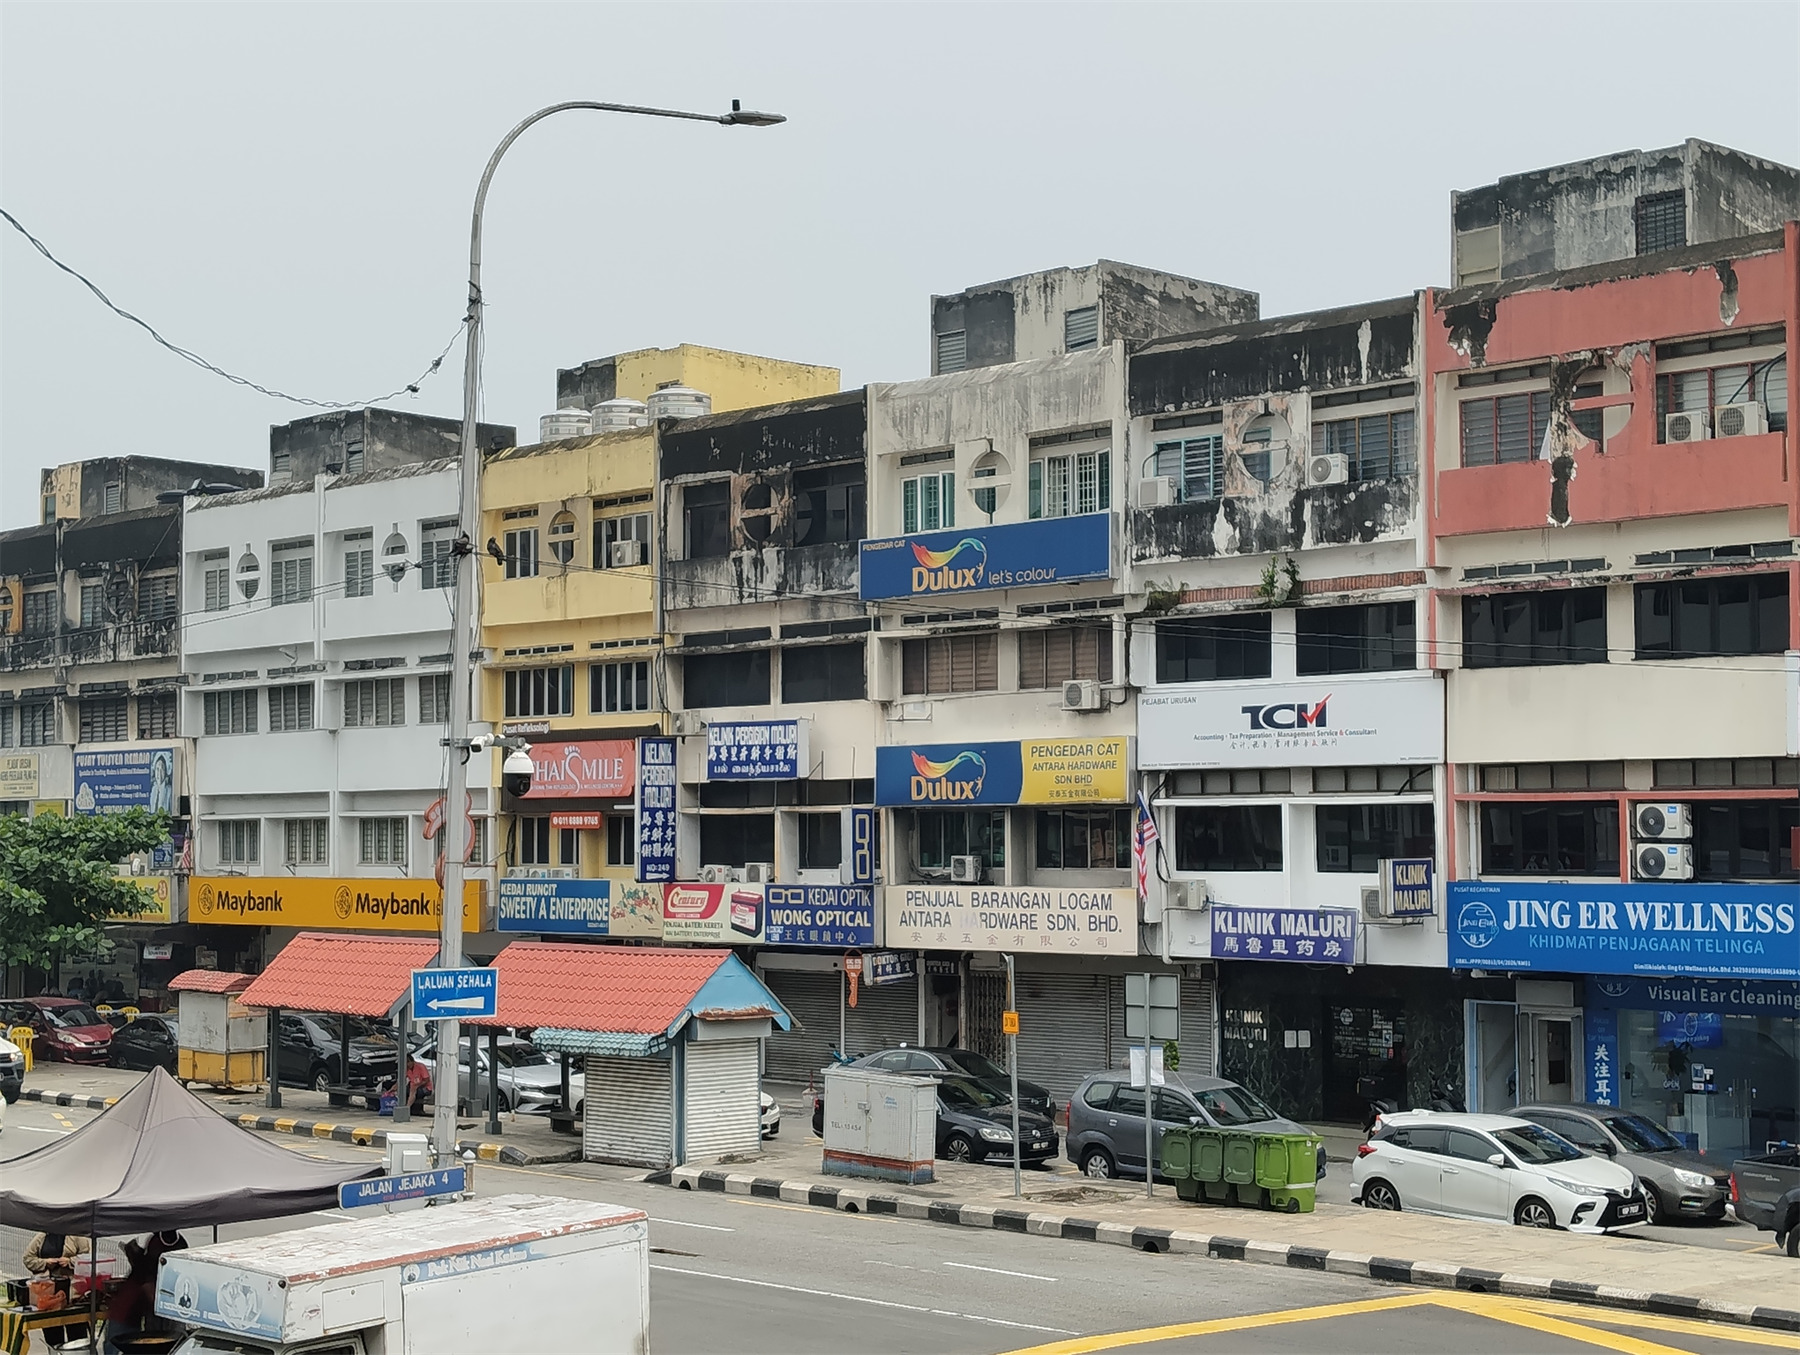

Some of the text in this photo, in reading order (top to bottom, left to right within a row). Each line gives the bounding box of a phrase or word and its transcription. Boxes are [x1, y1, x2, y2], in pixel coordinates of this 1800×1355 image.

[894, 539, 906, 549] CAT
[911, 566, 977, 593] Dulux
[988, 566, 1057, 585] let's colour
[1141, 696, 1197, 706] PEJABAT URUSAN
[503, 725, 518, 734] Pusat
[770, 724, 798, 745] MALURI
[1193, 733, 1225, 742] Accounting
[1229, 732, 1239, 740] Tax
[1240, 731, 1273, 741] Preparation
[1277, 730, 1316, 739] Management
[1316, 729, 1338, 737] Service
[1344, 728, 1378, 737] Consultant
[1031, 743, 1120, 758] PENGEDAR CAT
[1032, 760, 1118, 772] ANTARA HARDWARE
[911, 775, 975, 801] Dulux
[1054, 774, 1093, 785] SDN BHD
[1395, 863, 1428, 886] KLINIK
[500, 883, 558, 896] KEDAI RUNCIT
[670, 889, 707, 909] Century
[808, 888, 872, 907] KEDAI OPTIK
[216, 890, 283, 916] Maybank
[355, 891, 431, 920] Maybank
[500, 896, 609, 921] SWEETY A ENTERPRISE
[906, 891, 1113, 911] PENJUAL BARANGAN LOGAM
[1394, 888, 1431, 912] MALURI
[770, 909, 812, 926] WONG
[815, 909, 872, 927] OPTICAL
[899, 911, 952, 928] ANTARA
[1046, 913, 1081, 932] SDN.
[1088, 914, 1123, 933] BHD.
[1214, 910, 1352, 938] KLINIK MALURI
[1503, 899, 1796, 935] JING ER WELLNESS
[1529, 933, 1766, 955] KHIDMAT PENJAGAAN TELINGA
[872, 953, 898, 966] DOKTOR
[417, 974, 492, 989] LALUAN SEHALA
[1647, 985, 1800, 1011] Visual Ear Cleaning
[1225, 1009, 1264, 1025] KLINIK
[1223, 1026, 1268, 1042] MALURI
[1662, 1079, 1681, 1090] OPEN
[358, 1180, 393, 1197] JALAN
[398, 1173, 436, 1191] JEJAKA
[441, 1171, 449, 1185] 4
